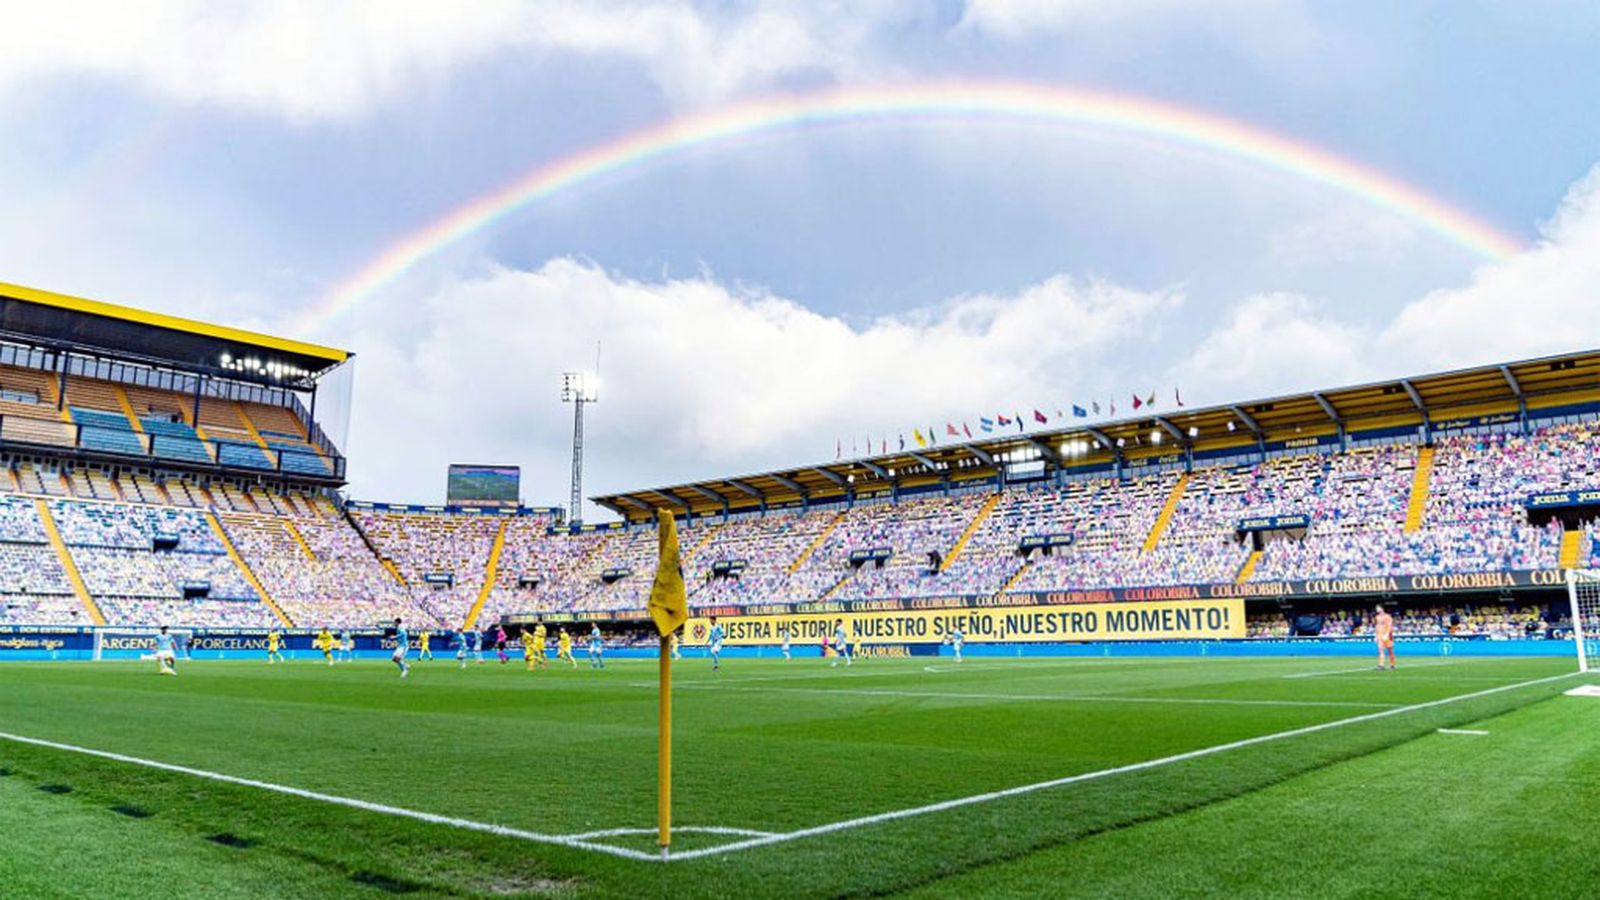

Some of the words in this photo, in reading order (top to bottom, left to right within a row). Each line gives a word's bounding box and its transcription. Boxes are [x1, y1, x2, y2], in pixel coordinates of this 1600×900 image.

[1124, 585, 1199, 600] COLOROBBIA
[1210, 582, 1293, 597] COLOROBBIA
[1305, 577, 1398, 594] COLOROBBIA
[1411, 571, 1516, 591] COLOROBBIA
[719, 621, 772, 639] UESTRA
[852, 616, 927, 637] NUESTRO
[1105, 607, 1230, 632] MOMENTO!
[101, 638, 157, 649] ARGENT
[193, 637, 287, 650] PORCELANOA
